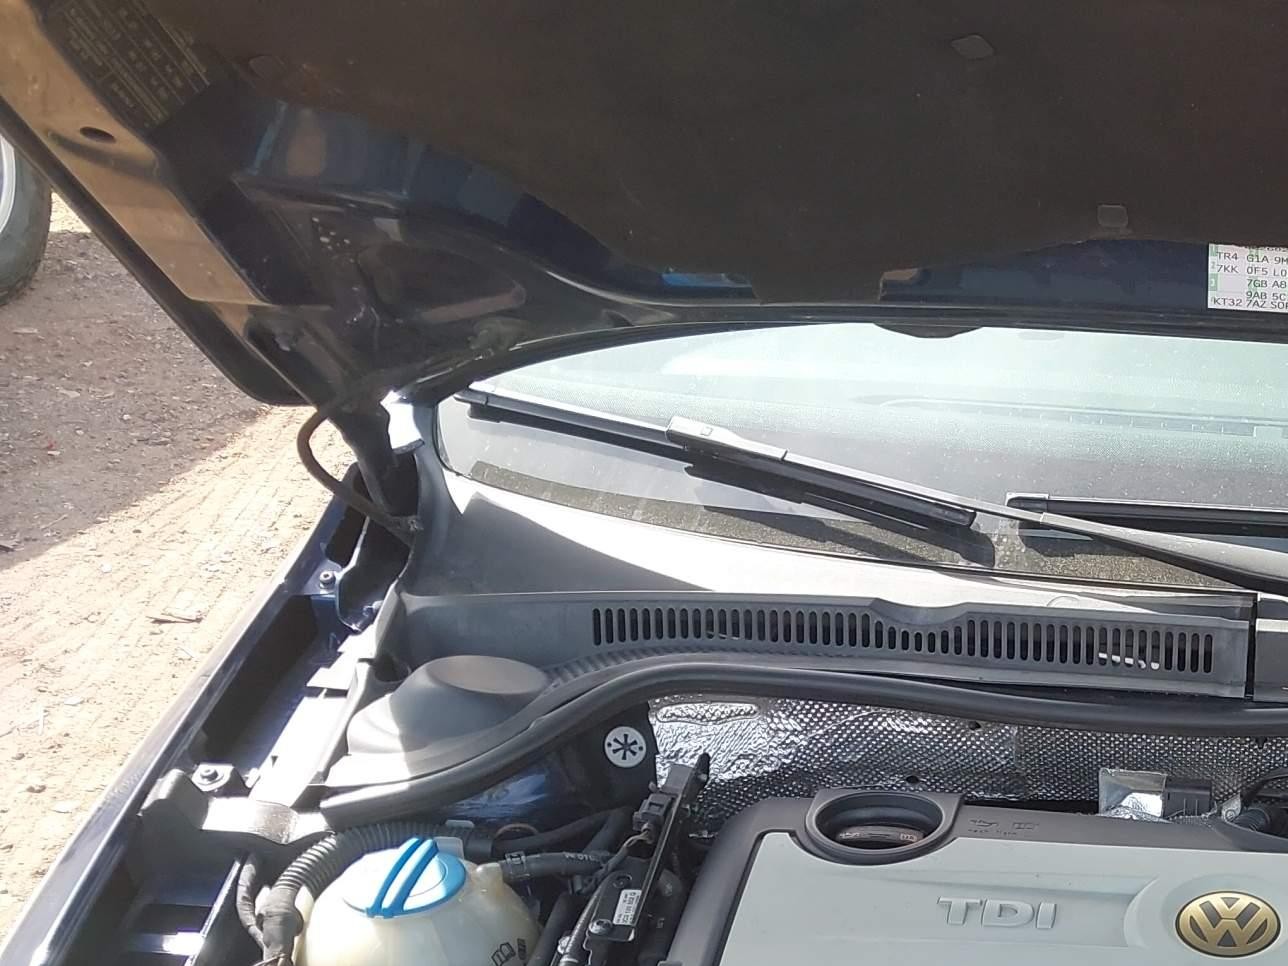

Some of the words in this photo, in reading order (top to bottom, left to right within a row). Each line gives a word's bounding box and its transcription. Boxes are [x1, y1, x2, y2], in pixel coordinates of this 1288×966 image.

[1217, 251, 1238, 261] TR4
[1217, 264, 1239, 273] 7KK
[1247, 266, 1268, 275] 0F5
[1246, 291, 1267, 300] 9AB
[1213, 297, 1243, 307] KT32
[936, 896, 1058, 930] TDI
[1176, 891, 1281, 957] VW
